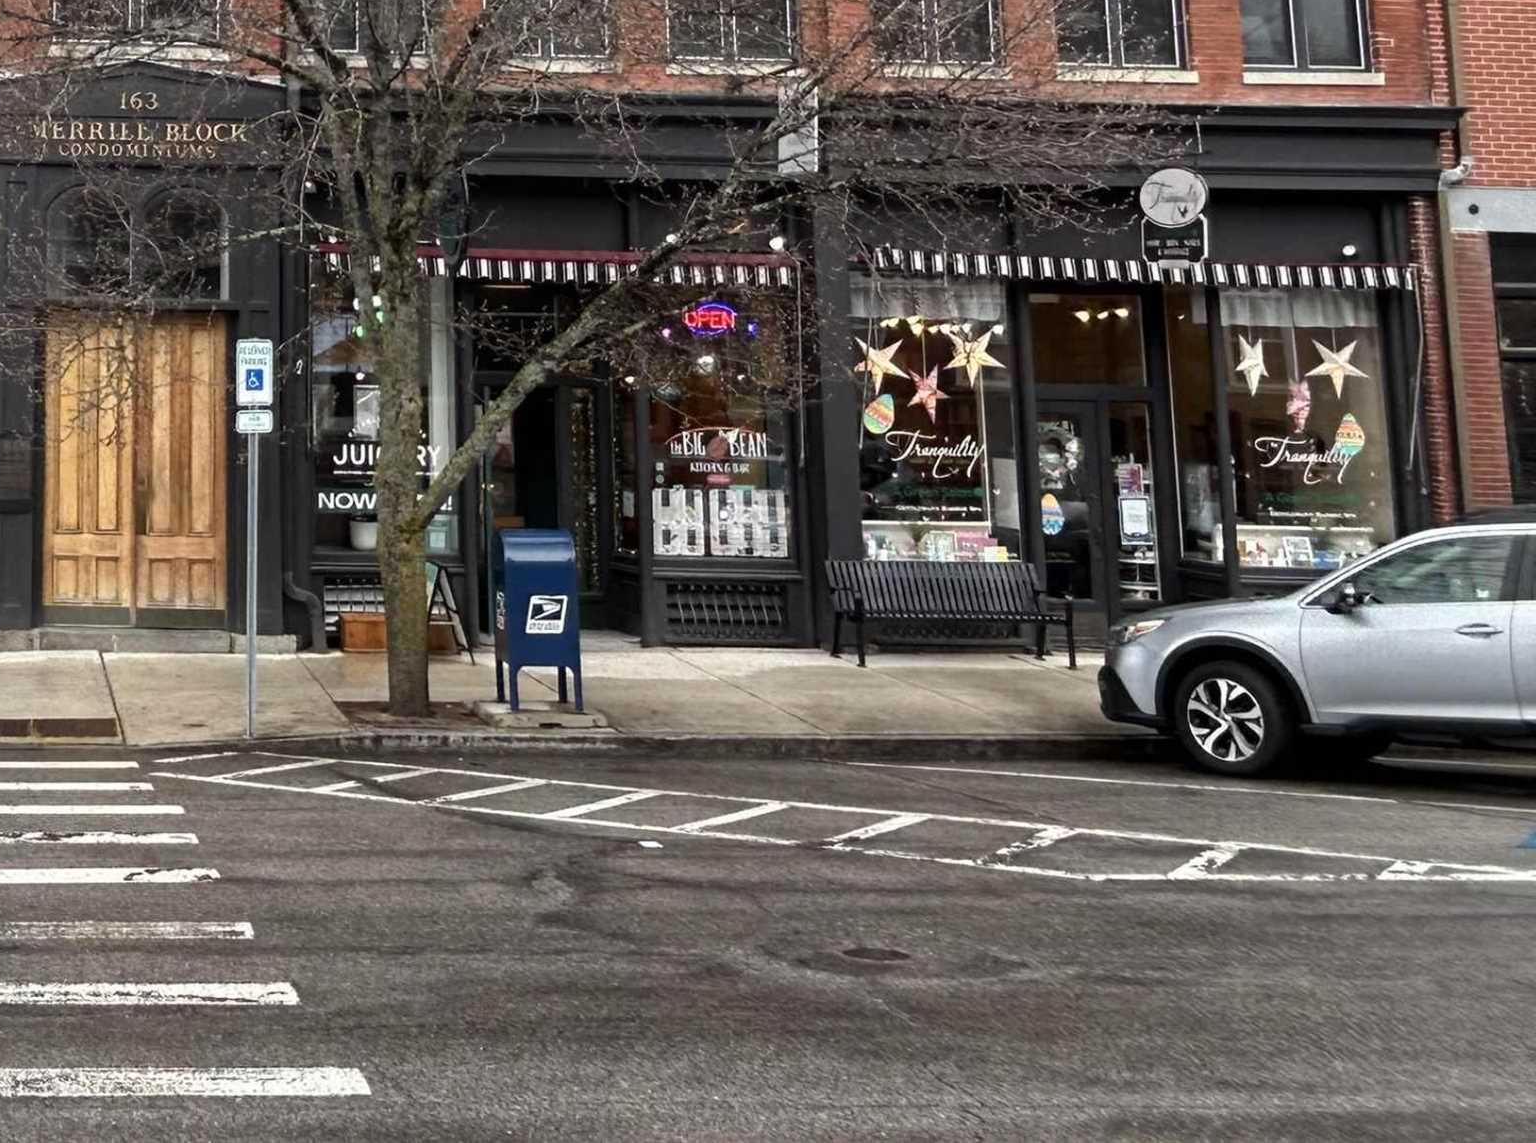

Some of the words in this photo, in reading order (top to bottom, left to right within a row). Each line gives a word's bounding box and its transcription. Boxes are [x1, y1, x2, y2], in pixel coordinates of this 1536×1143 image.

[120, 91, 159, 109] 163
[32, 121, 153, 142] MERRILL
[166, 122, 248, 142] BLOCK
[58, 143, 216, 158] CONDOMINIUMS
[684, 310, 735, 329] OPEN
[682, 431, 706, 456] BIG
[729, 431, 768, 458] BEAN
[885, 429, 986, 478] Tranquility
[333, 444, 441, 466] JUIRY
[318, 492, 377, 509] NOW
